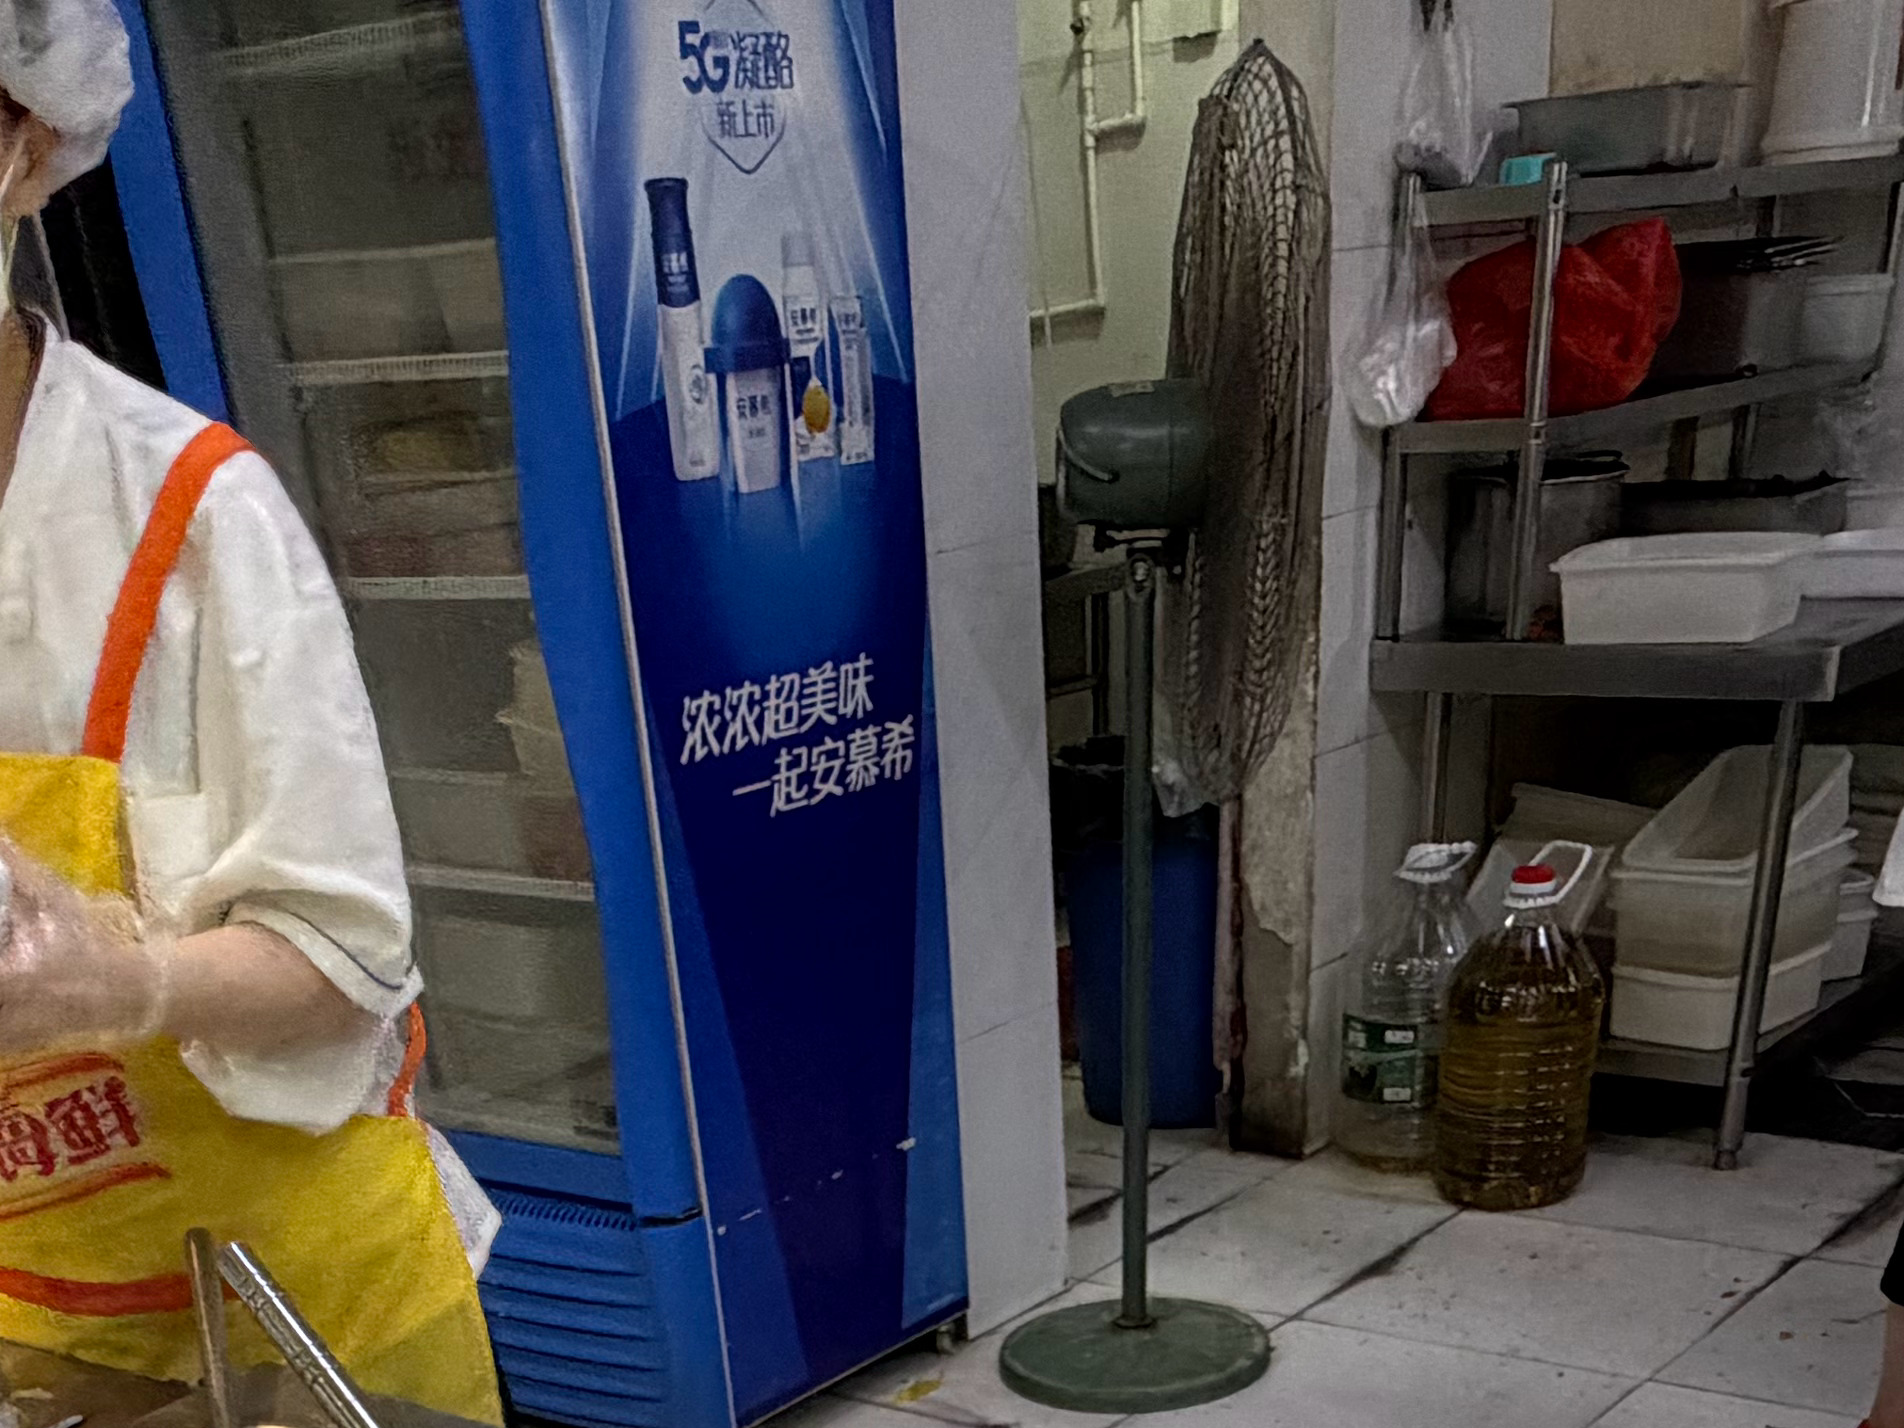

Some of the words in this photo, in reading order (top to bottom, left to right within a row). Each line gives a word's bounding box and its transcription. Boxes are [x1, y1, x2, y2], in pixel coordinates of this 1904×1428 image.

[717, 99, 775, 138] 新上市
[680, 652, 874, 765] 浓浓超美味
[732, 714, 915, 818] 一起安慕希
